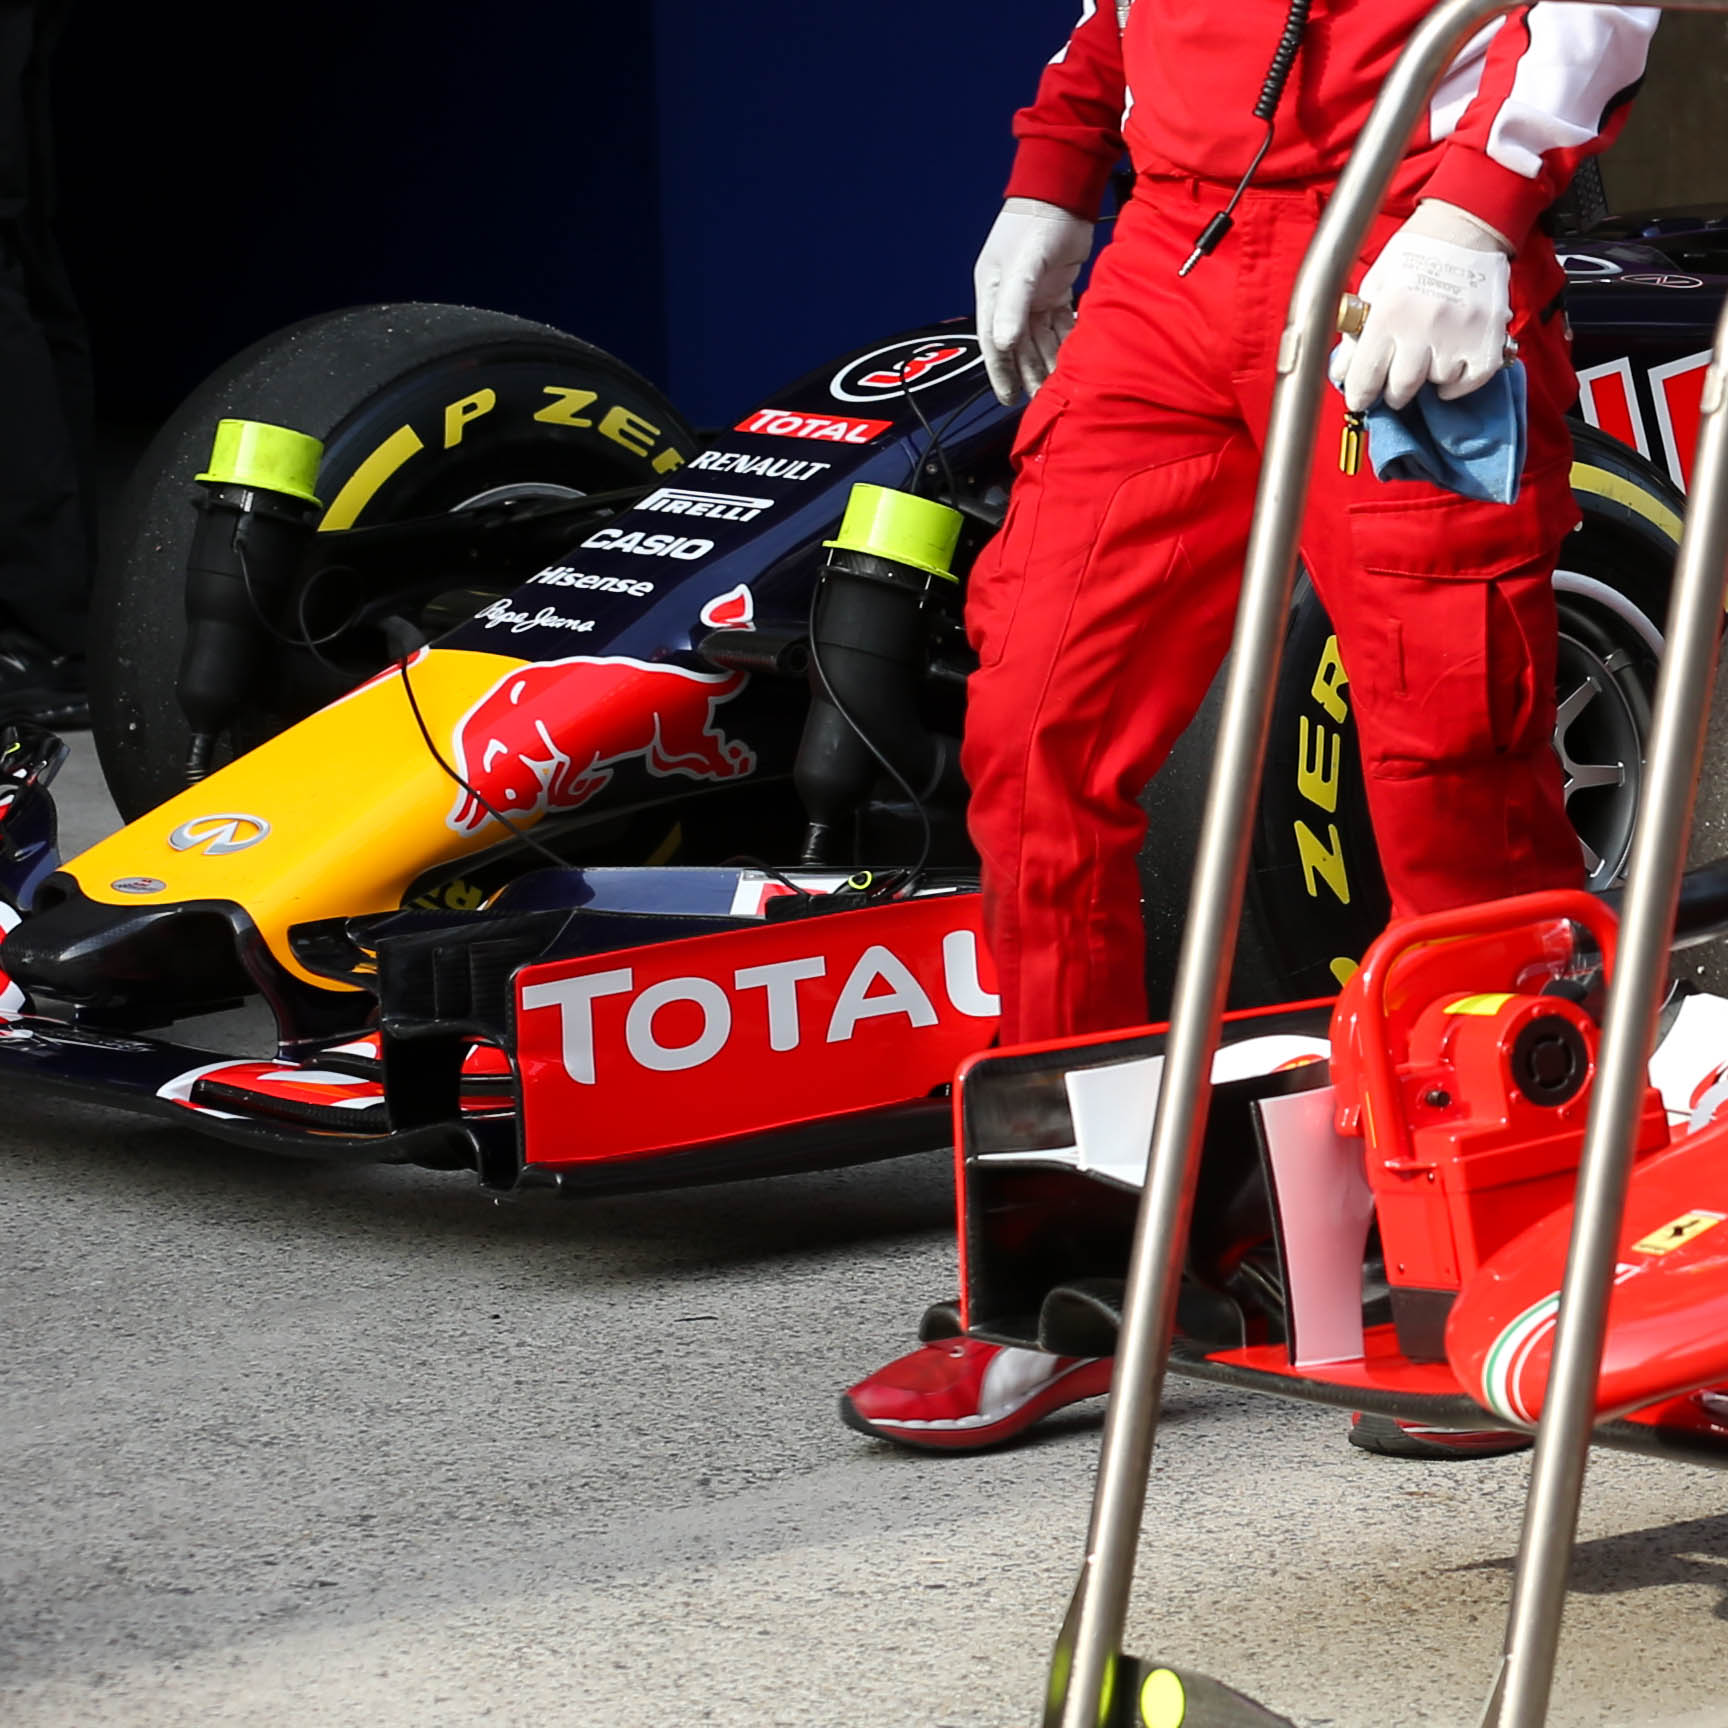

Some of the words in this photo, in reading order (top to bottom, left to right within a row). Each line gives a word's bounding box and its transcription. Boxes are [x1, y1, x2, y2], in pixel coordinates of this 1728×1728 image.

[857, 343, 968, 389] 3
[746, 407, 871, 445] TOTAL
[687, 450, 832, 482] RENAULT
[633, 487, 776, 523] PIRELLI
[579, 528, 716, 561] CASIO
[525, 565, 655, 598] Hisense
[474, 598, 533, 634] Pepe
[511, 605, 595, 634] Jeans
[521, 928, 1001, 1087] TOTAL
